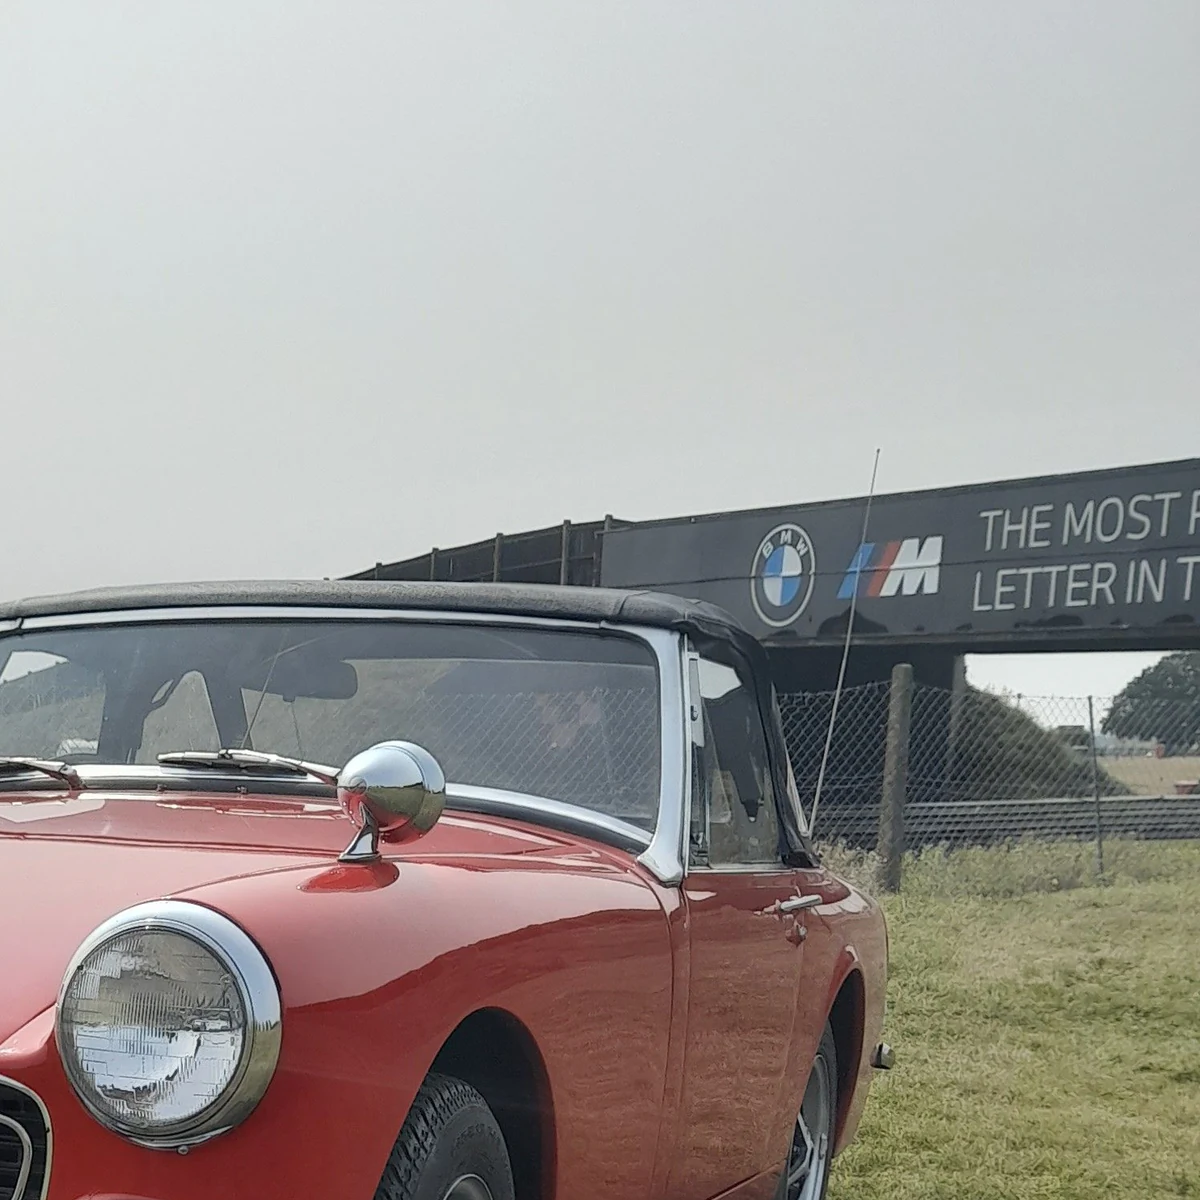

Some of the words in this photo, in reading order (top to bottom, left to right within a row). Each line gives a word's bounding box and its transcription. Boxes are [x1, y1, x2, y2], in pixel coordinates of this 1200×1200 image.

[762, 529, 809, 559] BMW
[979, 503, 1054, 551] THE
[1061, 491, 1182, 544] MOST
[879, 535, 943, 598] M
[972, 562, 1117, 611] LETTER
[1126, 557, 1167, 604] IN
